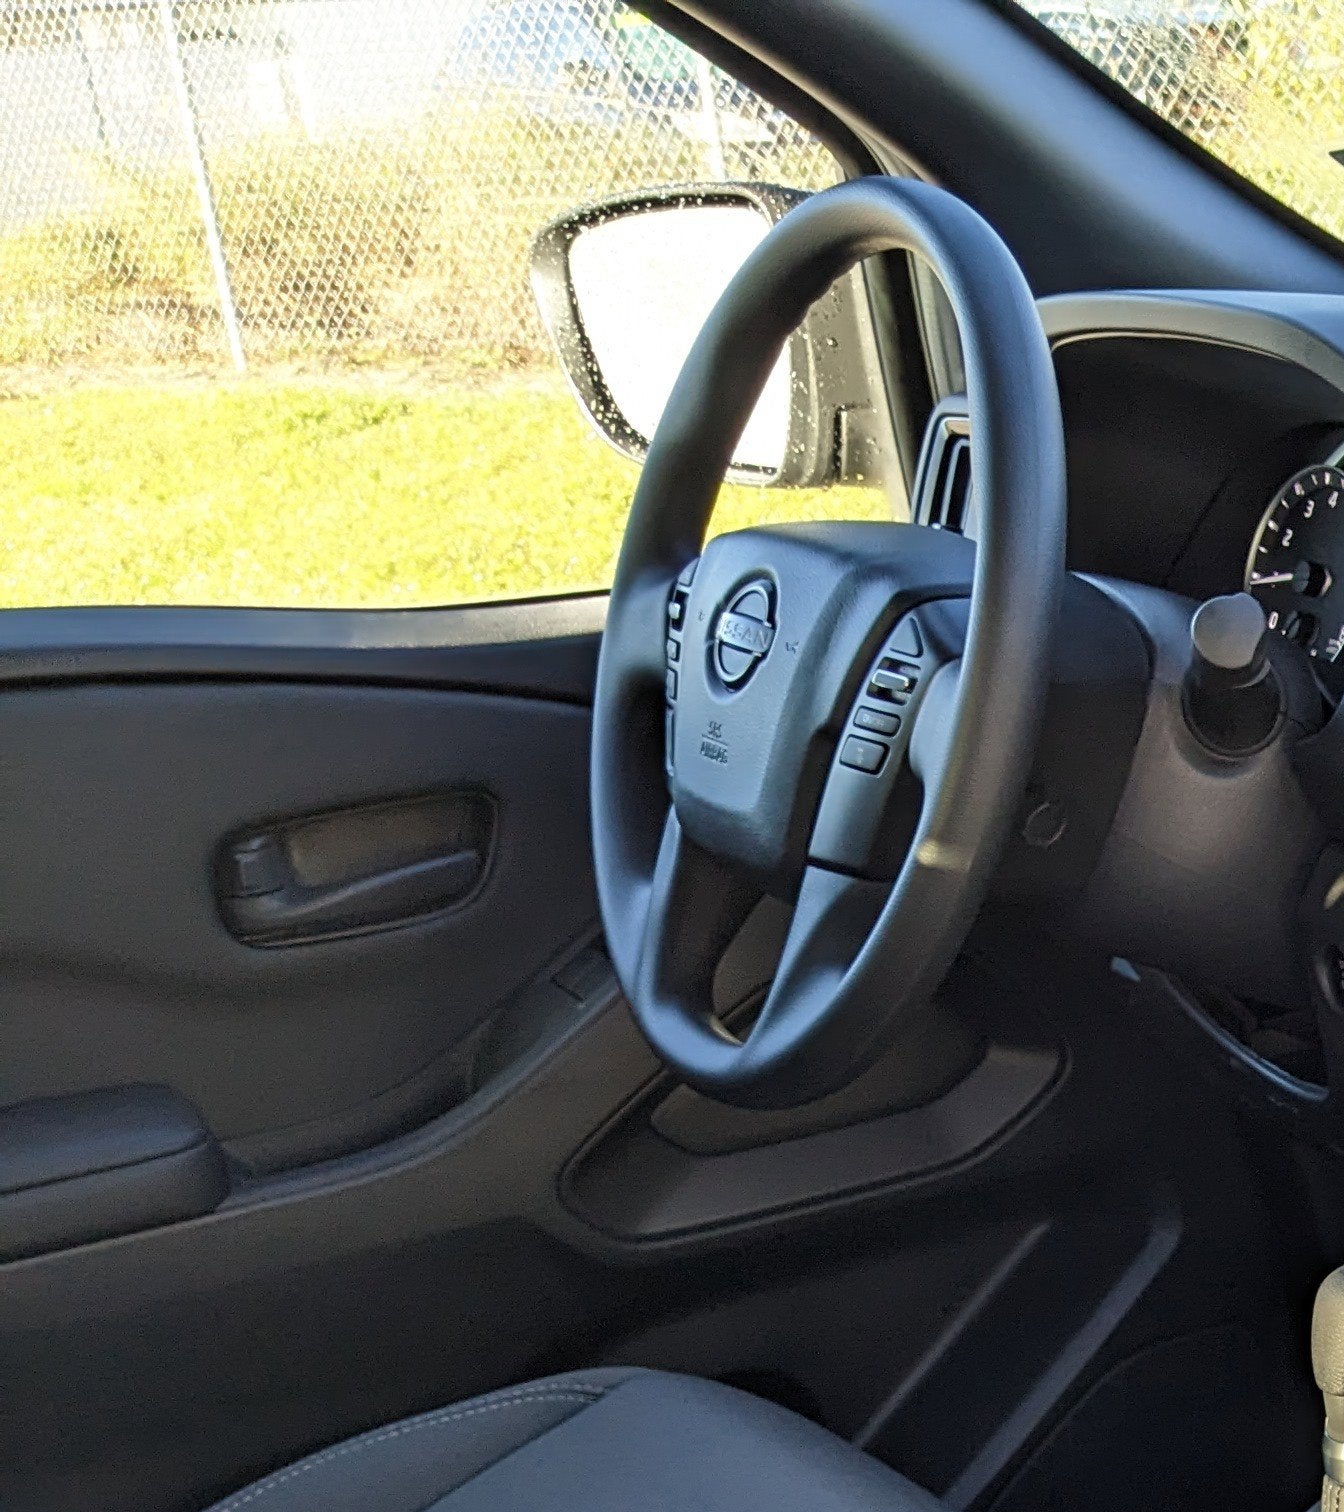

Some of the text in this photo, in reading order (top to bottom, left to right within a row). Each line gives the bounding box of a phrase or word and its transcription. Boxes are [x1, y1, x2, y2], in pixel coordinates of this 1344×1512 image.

[1328, 491, 1338, 508] 4
[1303, 500, 1314, 518] 3
[1282, 528, 1293, 547] 2
[1268, 611, 1279, 630] 0
